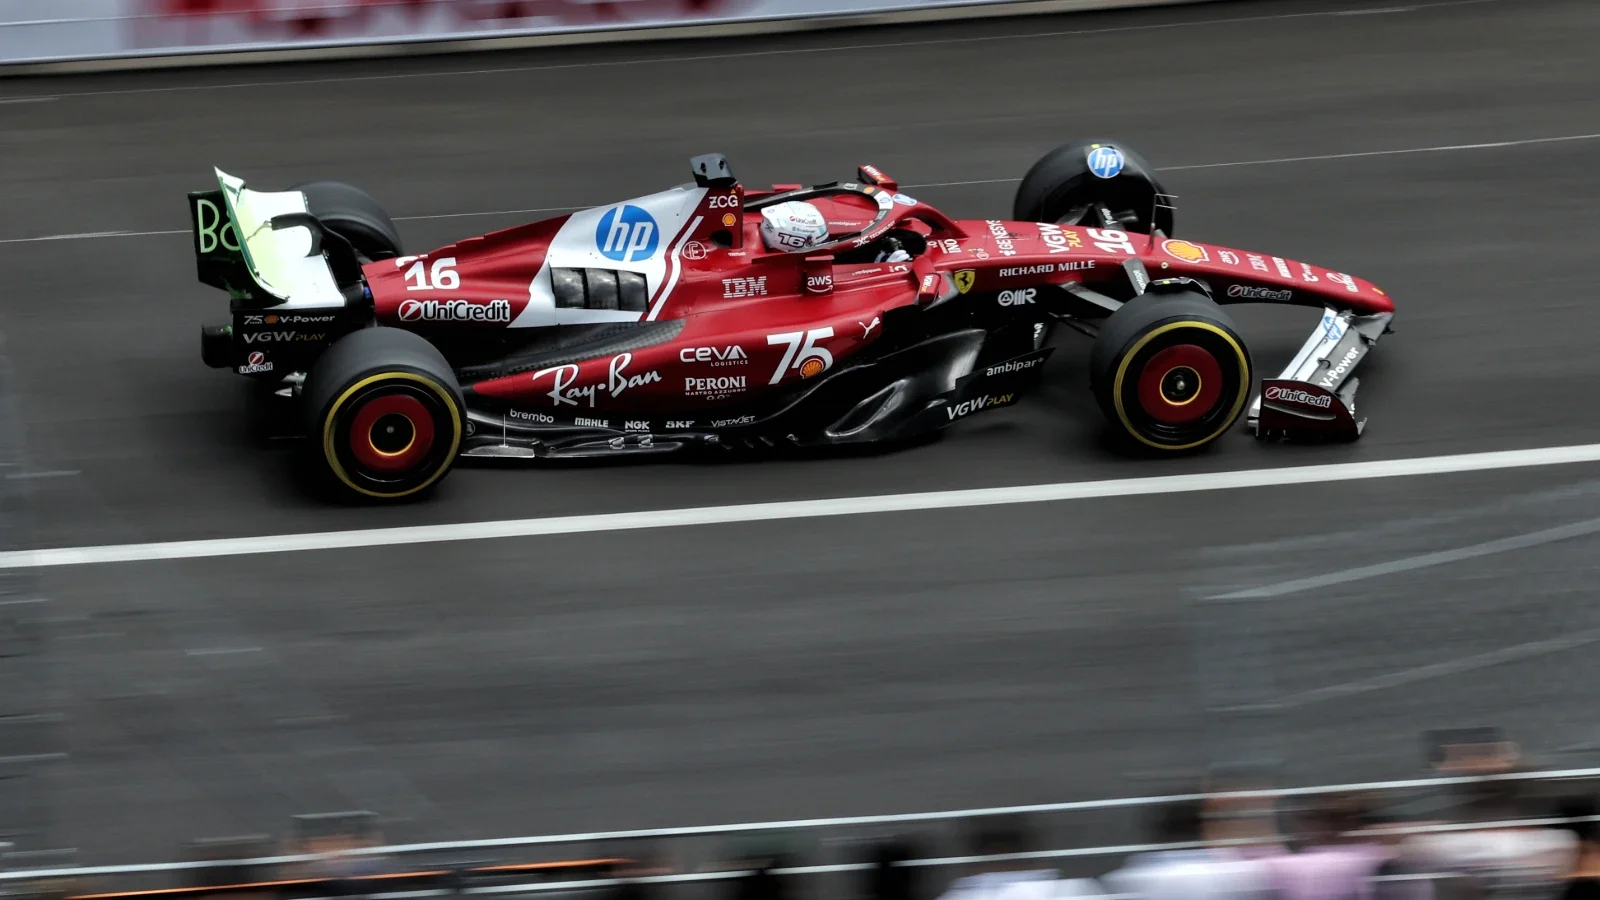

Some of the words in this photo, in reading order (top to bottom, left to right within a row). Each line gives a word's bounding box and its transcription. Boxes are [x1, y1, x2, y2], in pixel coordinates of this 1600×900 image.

[1094, 148, 1118, 178] hp
[603, 205, 654, 263] hp
[778, 232, 805, 248] 16
[1036, 222, 1070, 254] VGW
[1063, 229, 1083, 248] PLAY
[1085, 228, 1136, 255] 16
[404, 257, 460, 291] 16
[999, 264, 1054, 277] RICHARD
[1058, 259, 1095, 271] MILLE
[722, 275, 767, 298] IBM
[807, 275, 832, 286] aws
[1241, 287, 1292, 301] UniCredit
[423, 300, 510, 321] UniCredit
[243, 315, 263, 325] 75
[280, 315, 335, 323] V-Power
[242, 331, 296, 344] VGW
[295, 333, 326, 342] PLAY
[766, 326, 835, 385] 75
[986, 358, 1037, 376] ambipar
[1319, 347, 1359, 388] V-Power
[685, 375, 746, 391] PERONI
[946, 394, 989, 420] VGW
[986, 393, 1014, 407] PLAY
[1279, 388, 1331, 408] UniCredit
[510, 408, 554, 423] brembo
[574, 417, 609, 428] MAHLE
[665, 420, 695, 429] SKF
[625, 420, 650, 430] NGK
